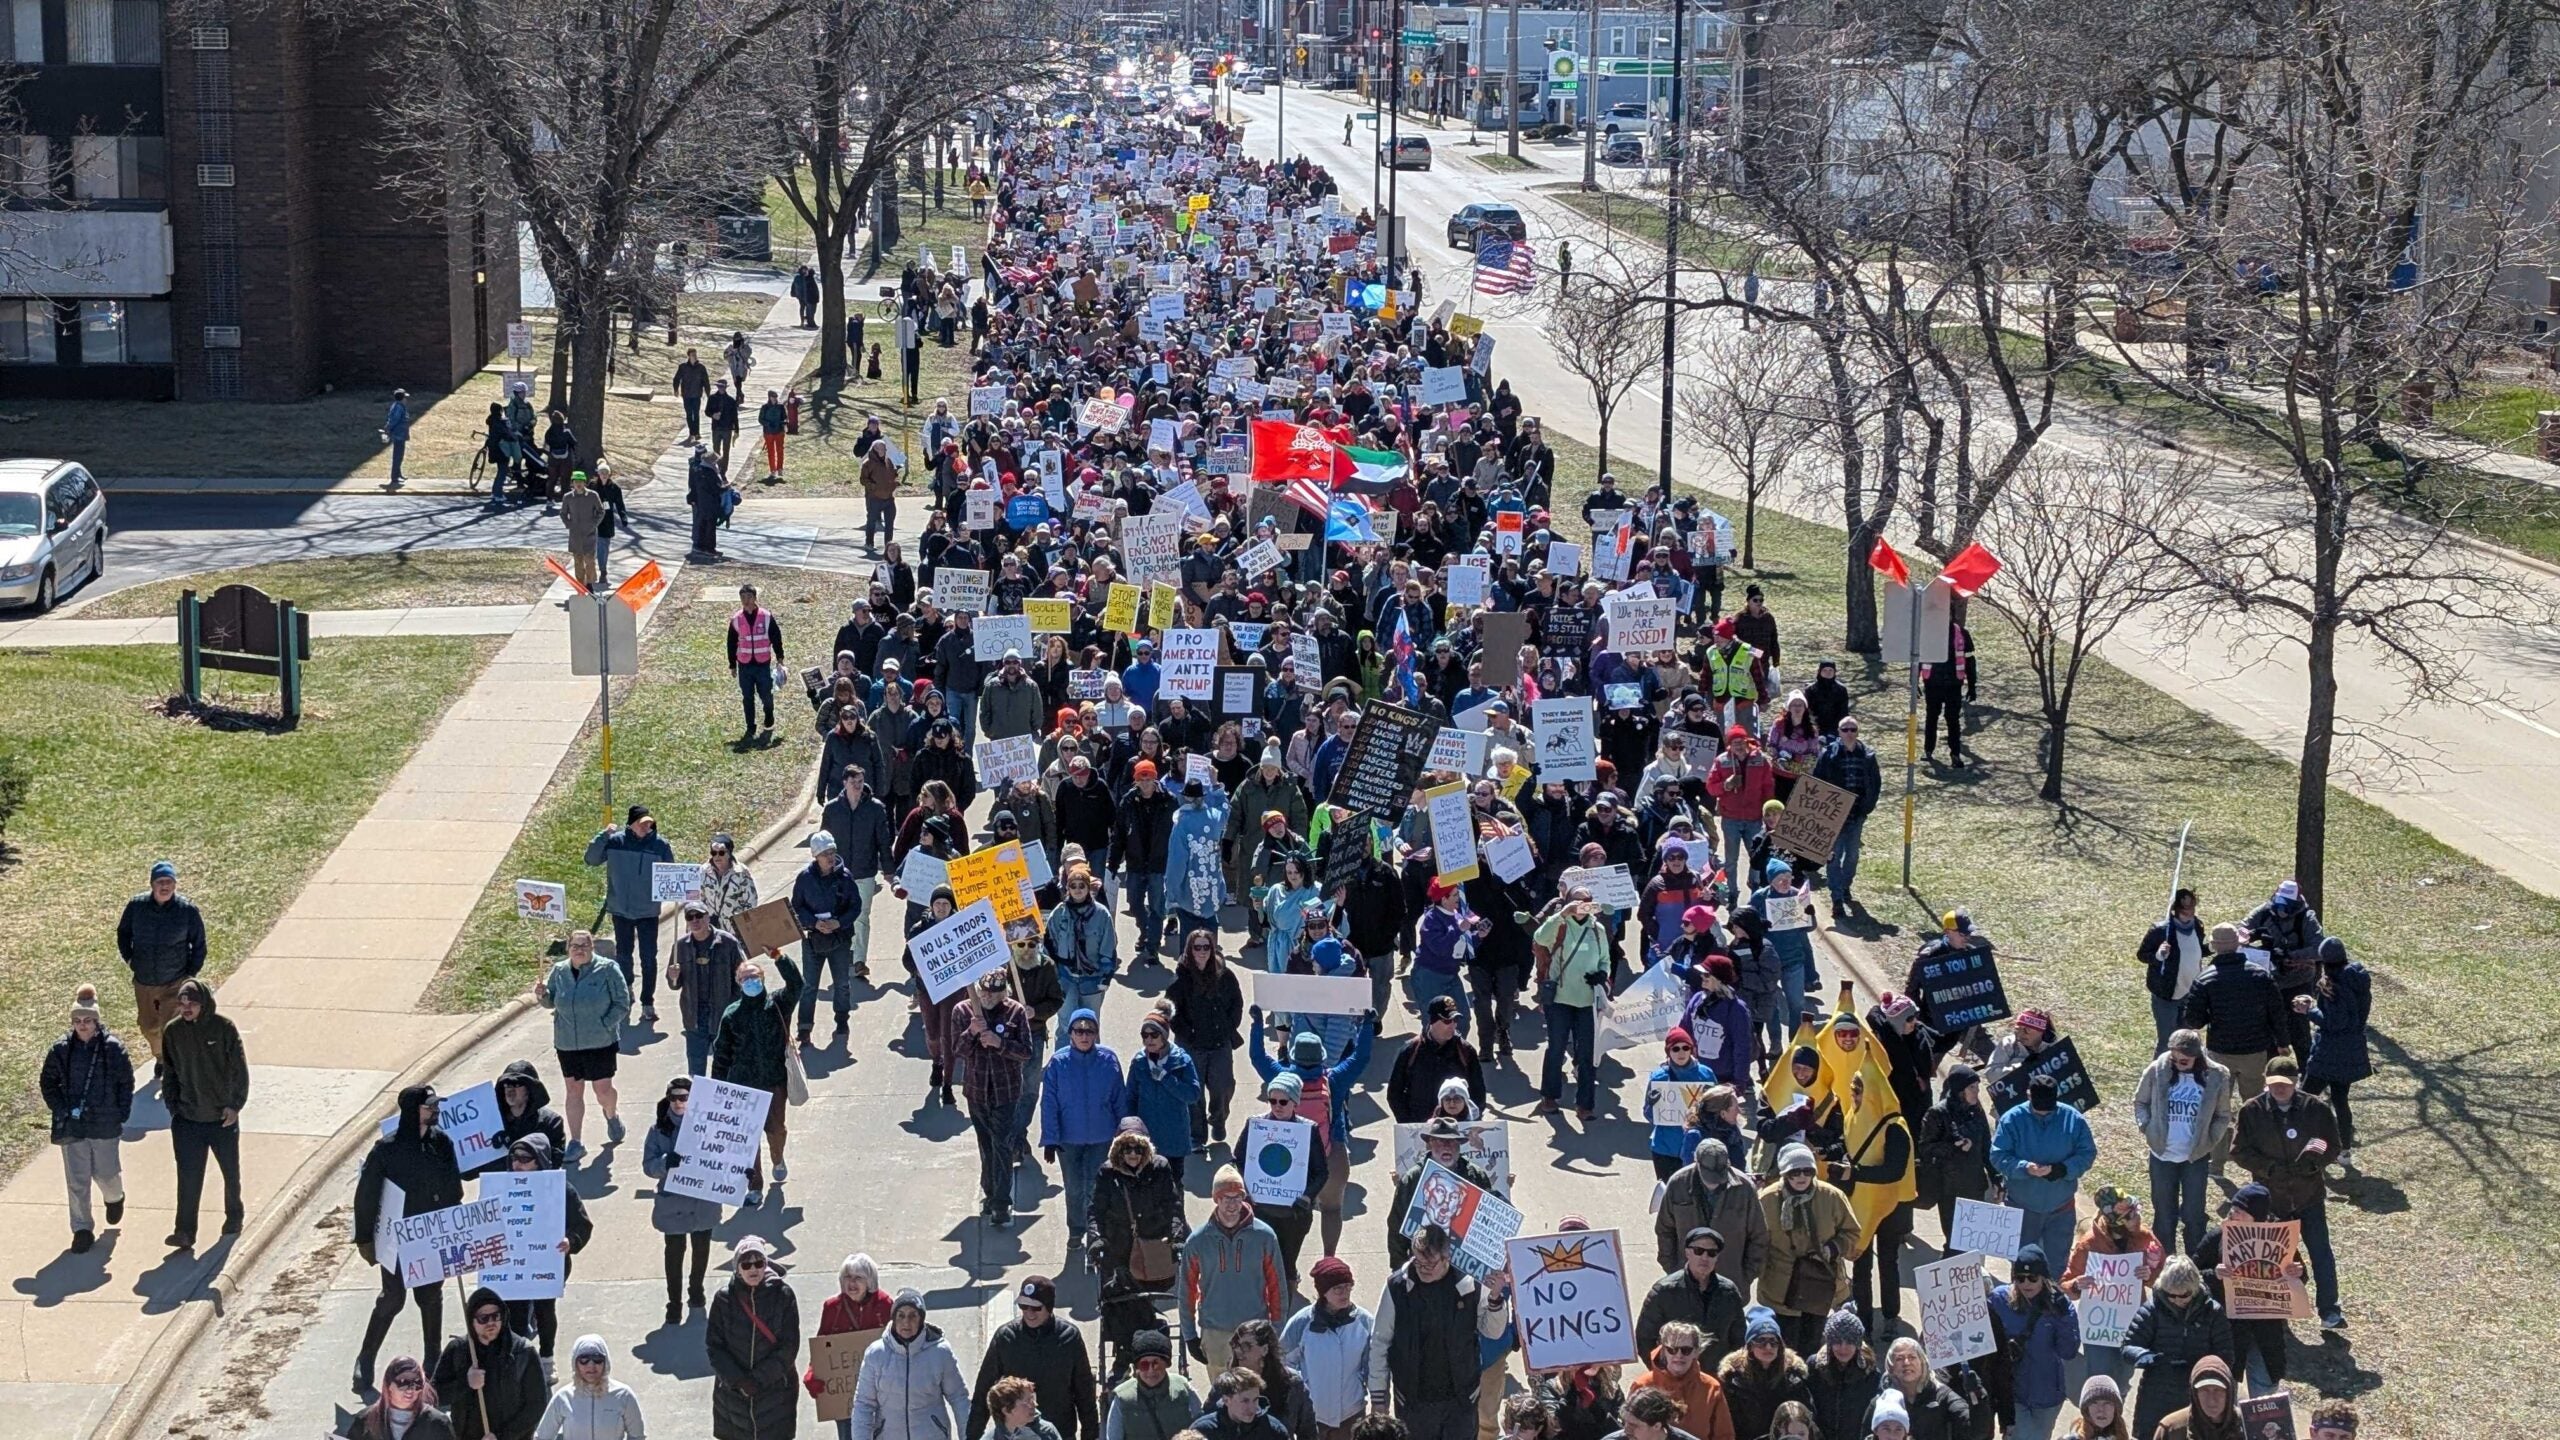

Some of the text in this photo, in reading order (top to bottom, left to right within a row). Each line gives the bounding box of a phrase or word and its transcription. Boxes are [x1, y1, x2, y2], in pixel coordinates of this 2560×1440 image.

[1140, 516, 1156, 526] IF
[1136, 534, 1174, 546] IS NOT
[1128, 544, 1177, 557] ENOUGH
[1129, 556, 1150, 566] YOU
[1240, 555, 1250, 563] NO
[1466, 558, 1487, 567] ICE
[1133, 563, 1180, 576] A PROBLEM
[951, 586, 984, 595] QUEENS
[1112, 588, 1136, 602] STOP
[1026, 604, 1067, 613] ABOLISH
[1617, 606, 1631, 619] We
[1651, 605, 1672, 618] People
[978, 618, 1024, 630] PATRIOTS
[1036, 616, 1058, 625] ICE
[1550, 614, 1576, 624] PRIDE
[1632, 618, 1655, 629] ARE
[1560, 624, 1586, 634] STILL
[1618, 628, 1667, 645] PISSED!
[982, 638, 1023, 655] GOOD
[1176, 634, 1202, 645] PRO
[1548, 635, 1584, 646] PROTEST
[1163, 648, 1216, 660] AMERICA
[1174, 664, 1210, 675] ANTI
[1168, 678, 1211, 690] TRUMP
[1370, 706, 1386, 716] NO
[1376, 720, 1403, 732] FELONS
[1373, 728, 1403, 742] RACISTS
[997, 738, 1016, 753] THE
[1369, 737, 1399, 750] RAPISTS
[1436, 738, 1466, 749] REMOVE
[1367, 746, 1396, 760] TYRANTS
[1434, 747, 1467, 758] ARREST
[1362, 754, 1399, 770] FASCISTS
[1433, 756, 1466, 768] LOCK UP
[1358, 763, 1396, 779] GRIFTERS
[1351, 780, 1393, 796] DICTATORS
[1355, 772, 1404, 790] FRAUDSTERS
[1348, 789, 1391, 806] MALIGNANT
[1805, 781, 1844, 809] We The
[1799, 794, 1841, 821] PEOPLE
[1780, 824, 1834, 852] TOGETHER
[951, 875, 964, 883] my
[955, 868, 1020, 897] trumps on the
[658, 881, 689, 893] GREAT
[1001, 886, 1014, 896] the
[1003, 906, 1024, 920] bottle
[920, 912, 988, 957] NO U.S. TROOPS
[926, 927, 993, 971] ON U.S. STREETS
[959, 944, 996, 969] COMITATUS
[1923, 954, 1982, 979] SEE YOU IN
[1932, 979, 1994, 1004] NUREMBERG
[1614, 1009, 1656, 1024] OF DANE
[2028, 1051, 2069, 1085] KINGS
[716, 1085, 749, 1100] NO ONE
[1987, 1080, 2005, 1096] NO
[724, 1101, 732, 1110] IS
[2168, 1100, 2199, 1116] ROYS
[707, 1112, 740, 1126] ILLEGAL
[694, 1125, 748, 1144] ON STOLEN
[701, 1141, 725, 1153] LAND
[699, 1159, 744, 1174] WALK ON
[672, 1175, 735, 1194] NATIVE LAND
[1259, 1176, 1282, 1186] without
[1482, 1194, 1521, 1222] UNCIVIL
[394, 1198, 502, 1245] REGIME CHANGE
[1478, 1202, 1518, 1232] UNETHICAL
[1957, 1202, 2016, 1230] WE THE
[1475, 1212, 1513, 1237] UNKIND
[430, 1230, 473, 1249] STARTS
[1960, 1226, 2016, 1256] PEOPLE
[1465, 1236, 1503, 1262] UNHINGED
[2228, 1241, 2288, 1269] MAY DAY
[408, 1233, 512, 1282] AT HOME
[1929, 1262, 1981, 1289] I PREFER
[2100, 1259, 2129, 1277] NO
[2232, 1261, 2281, 1280] STRIKE
[1534, 1281, 1577, 1306] NO
[1950, 1280, 1981, 1308] ICE
[2088, 1284, 2134, 1305] MORE
[2271, 1292, 2291, 1301] ICE
[2088, 1305, 2124, 1330] OIL
[1526, 1307, 1621, 1346] KINGS
[2086, 1327, 2126, 1344] WARS
